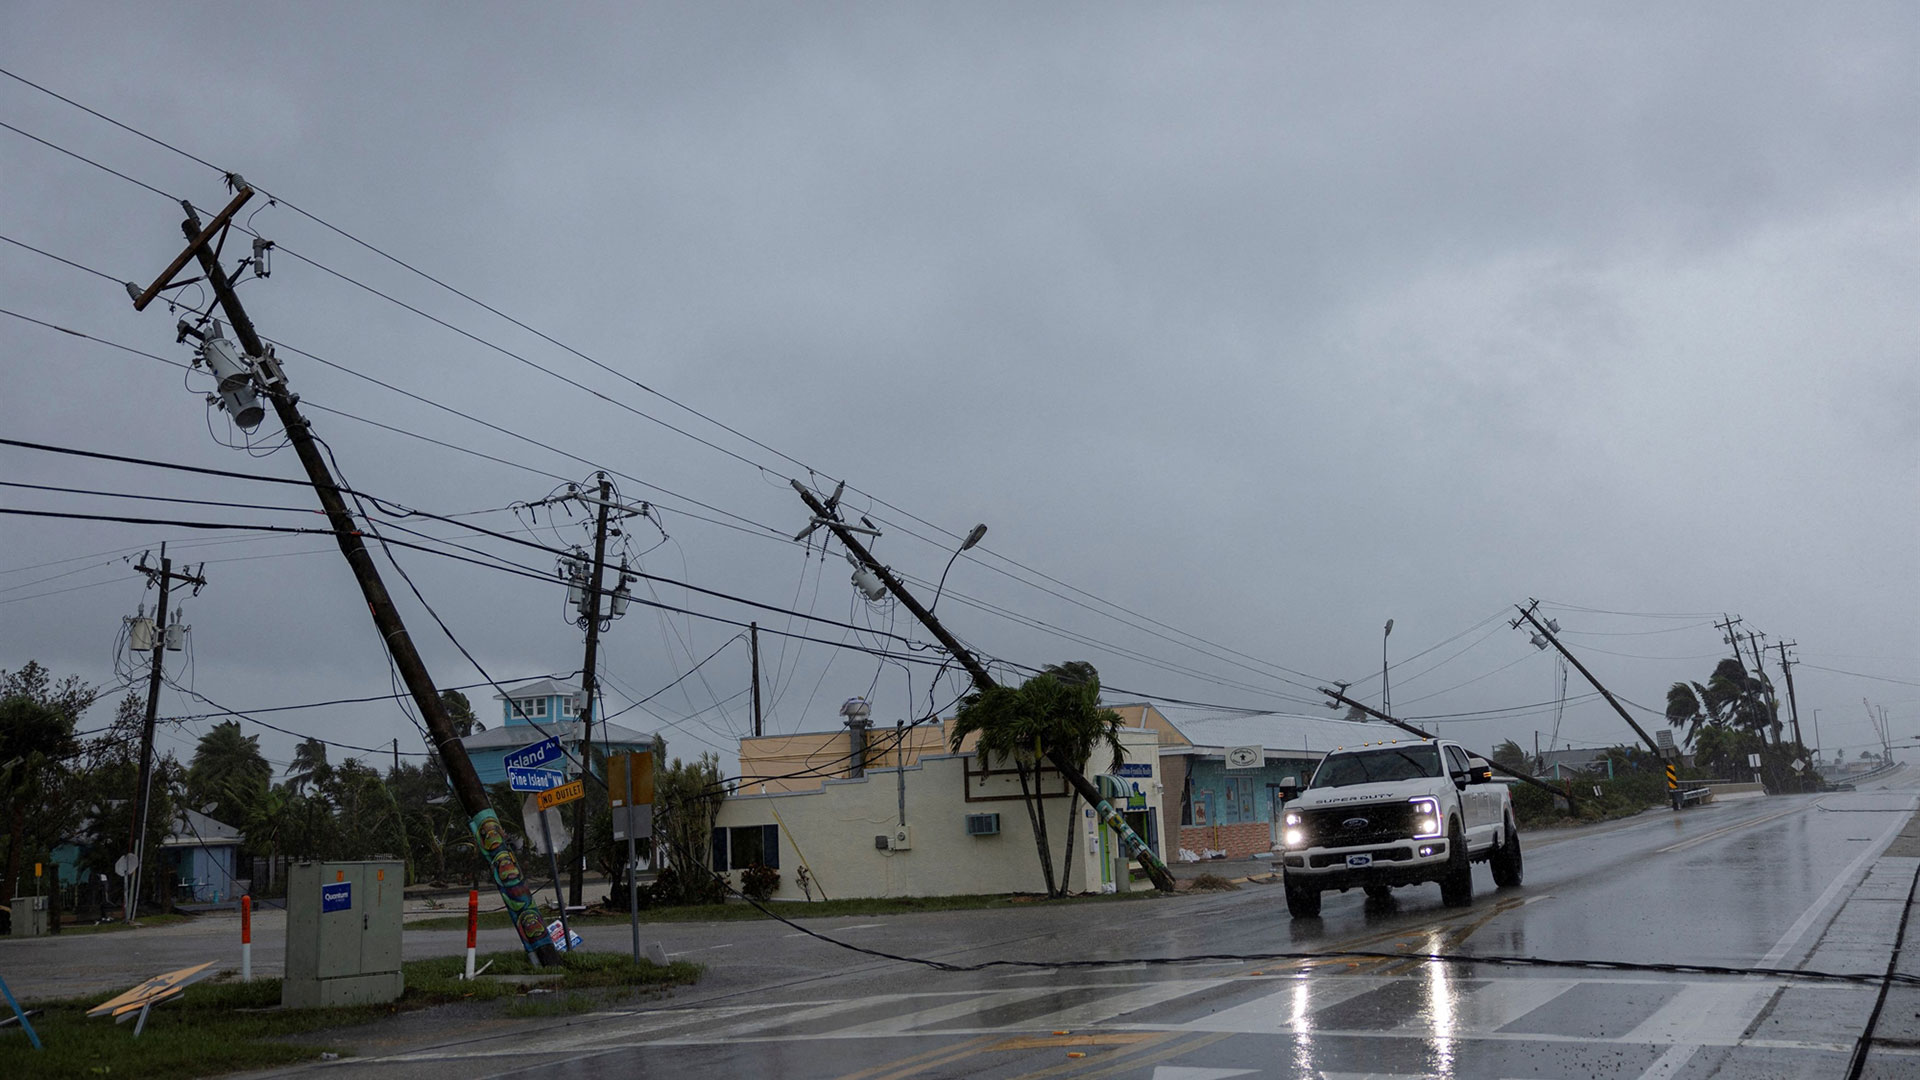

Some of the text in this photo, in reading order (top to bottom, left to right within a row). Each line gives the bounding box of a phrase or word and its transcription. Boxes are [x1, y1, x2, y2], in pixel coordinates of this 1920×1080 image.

[509, 746, 545, 768] Island
[510, 772, 527, 786] Pine
[528, 773, 549, 787] Island
[552, 775, 563, 787] NW
[542, 785, 581, 804] NO OUTLET
[1316, 796, 1357, 804] SUPER
